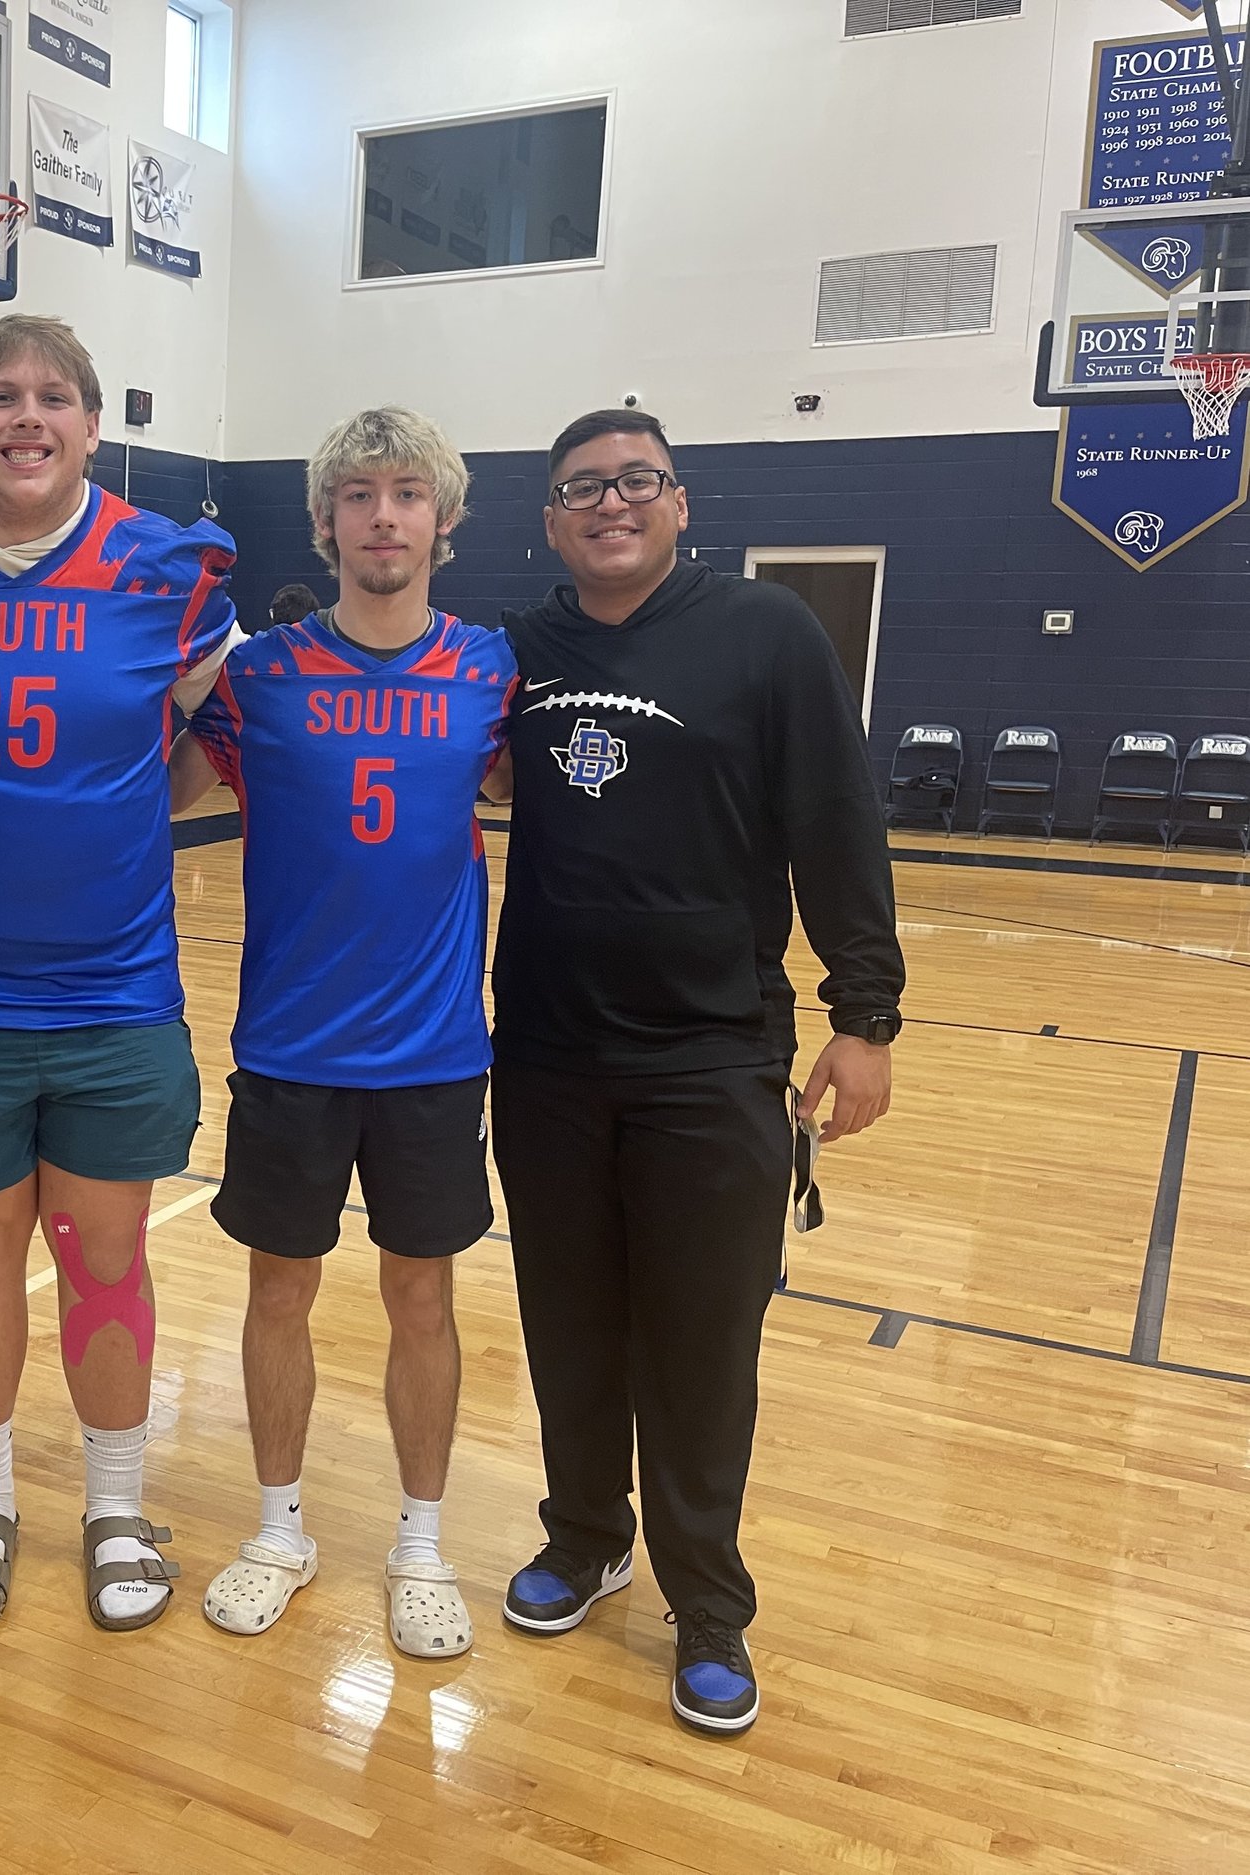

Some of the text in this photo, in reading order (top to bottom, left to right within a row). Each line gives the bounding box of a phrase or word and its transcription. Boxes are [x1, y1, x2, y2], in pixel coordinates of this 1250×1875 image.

[1103, 109, 1130, 121] 1910
[1136, 107, 1160, 118] 1911
[1170, 101, 1197, 115] 1918
[1102, 114, 1228, 137] 1924 1931 1960 196
[61, 129, 78, 154] The
[1100, 139, 1129, 153] 1996
[1135, 136, 1163, 150] 1998
[1166, 134, 1197, 146] 2001
[33, 149, 72, 180] Gaither
[39, 206, 102, 234] PROUD SPONSOR
[1078, 326, 1147, 354] BOYS
[1076, 468, 1098, 478] 1968
[306, 688, 448, 738] SOUTH
[1122, 735, 1167, 751] RAMS
[1201, 738, 1247, 755] RAMS
[351, 758, 395, 844] 5
[116, 1583, 148, 1594] DRI-FIT
